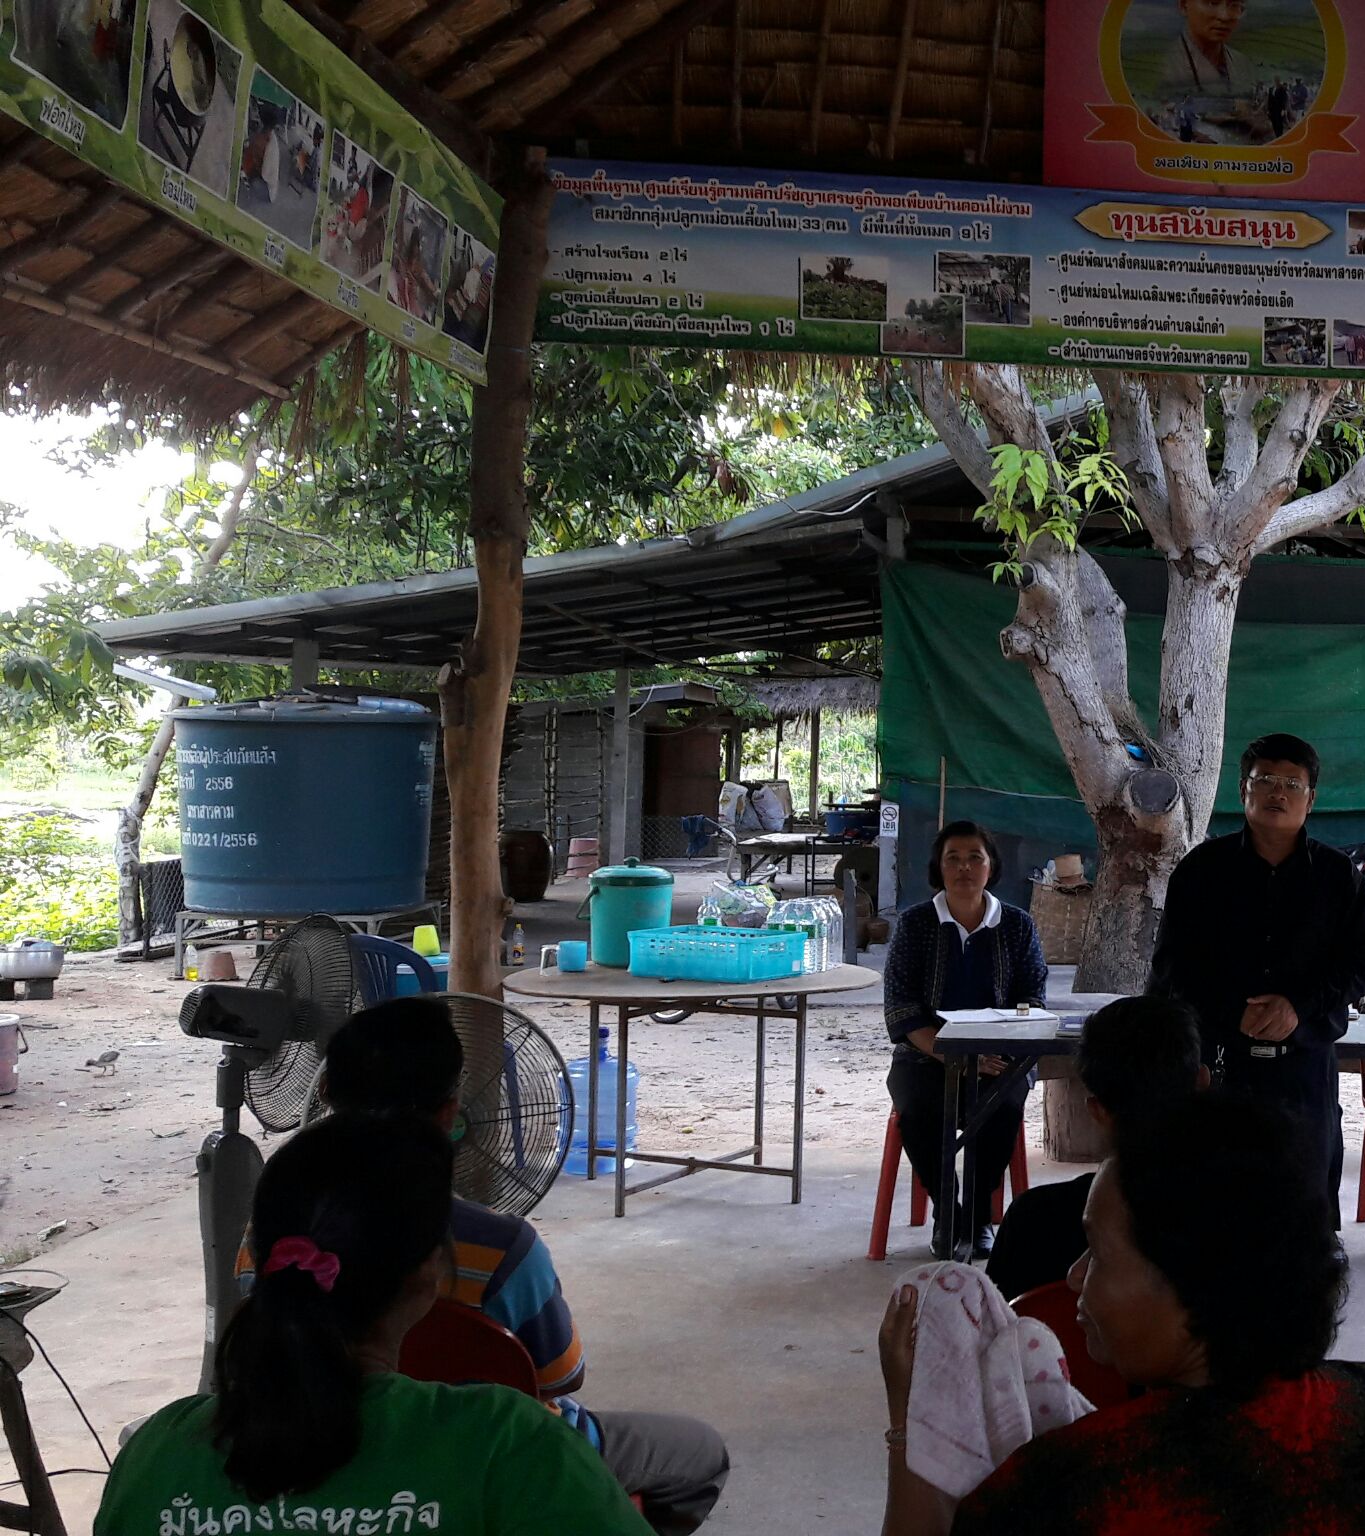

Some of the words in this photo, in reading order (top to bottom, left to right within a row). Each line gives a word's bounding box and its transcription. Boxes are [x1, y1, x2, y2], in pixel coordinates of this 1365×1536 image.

[1154, 155, 1209, 170] พอเพียง
[1213, 157, 1294, 174] ตามรอยพ่อ
[801, 218, 821, 230] 33
[825, 218, 847, 231] คน
[974, 223, 991, 240] ไร่
[1110, 207, 1297, 246] ทุนสนับสนุน
[673, 247, 688, 262] ไร่
[663, 269, 676, 284] ไร่
[687, 293, 703, 308] ไร่
[777, 318, 795, 336] ไร่
[205, 775, 234, 791] 2556
